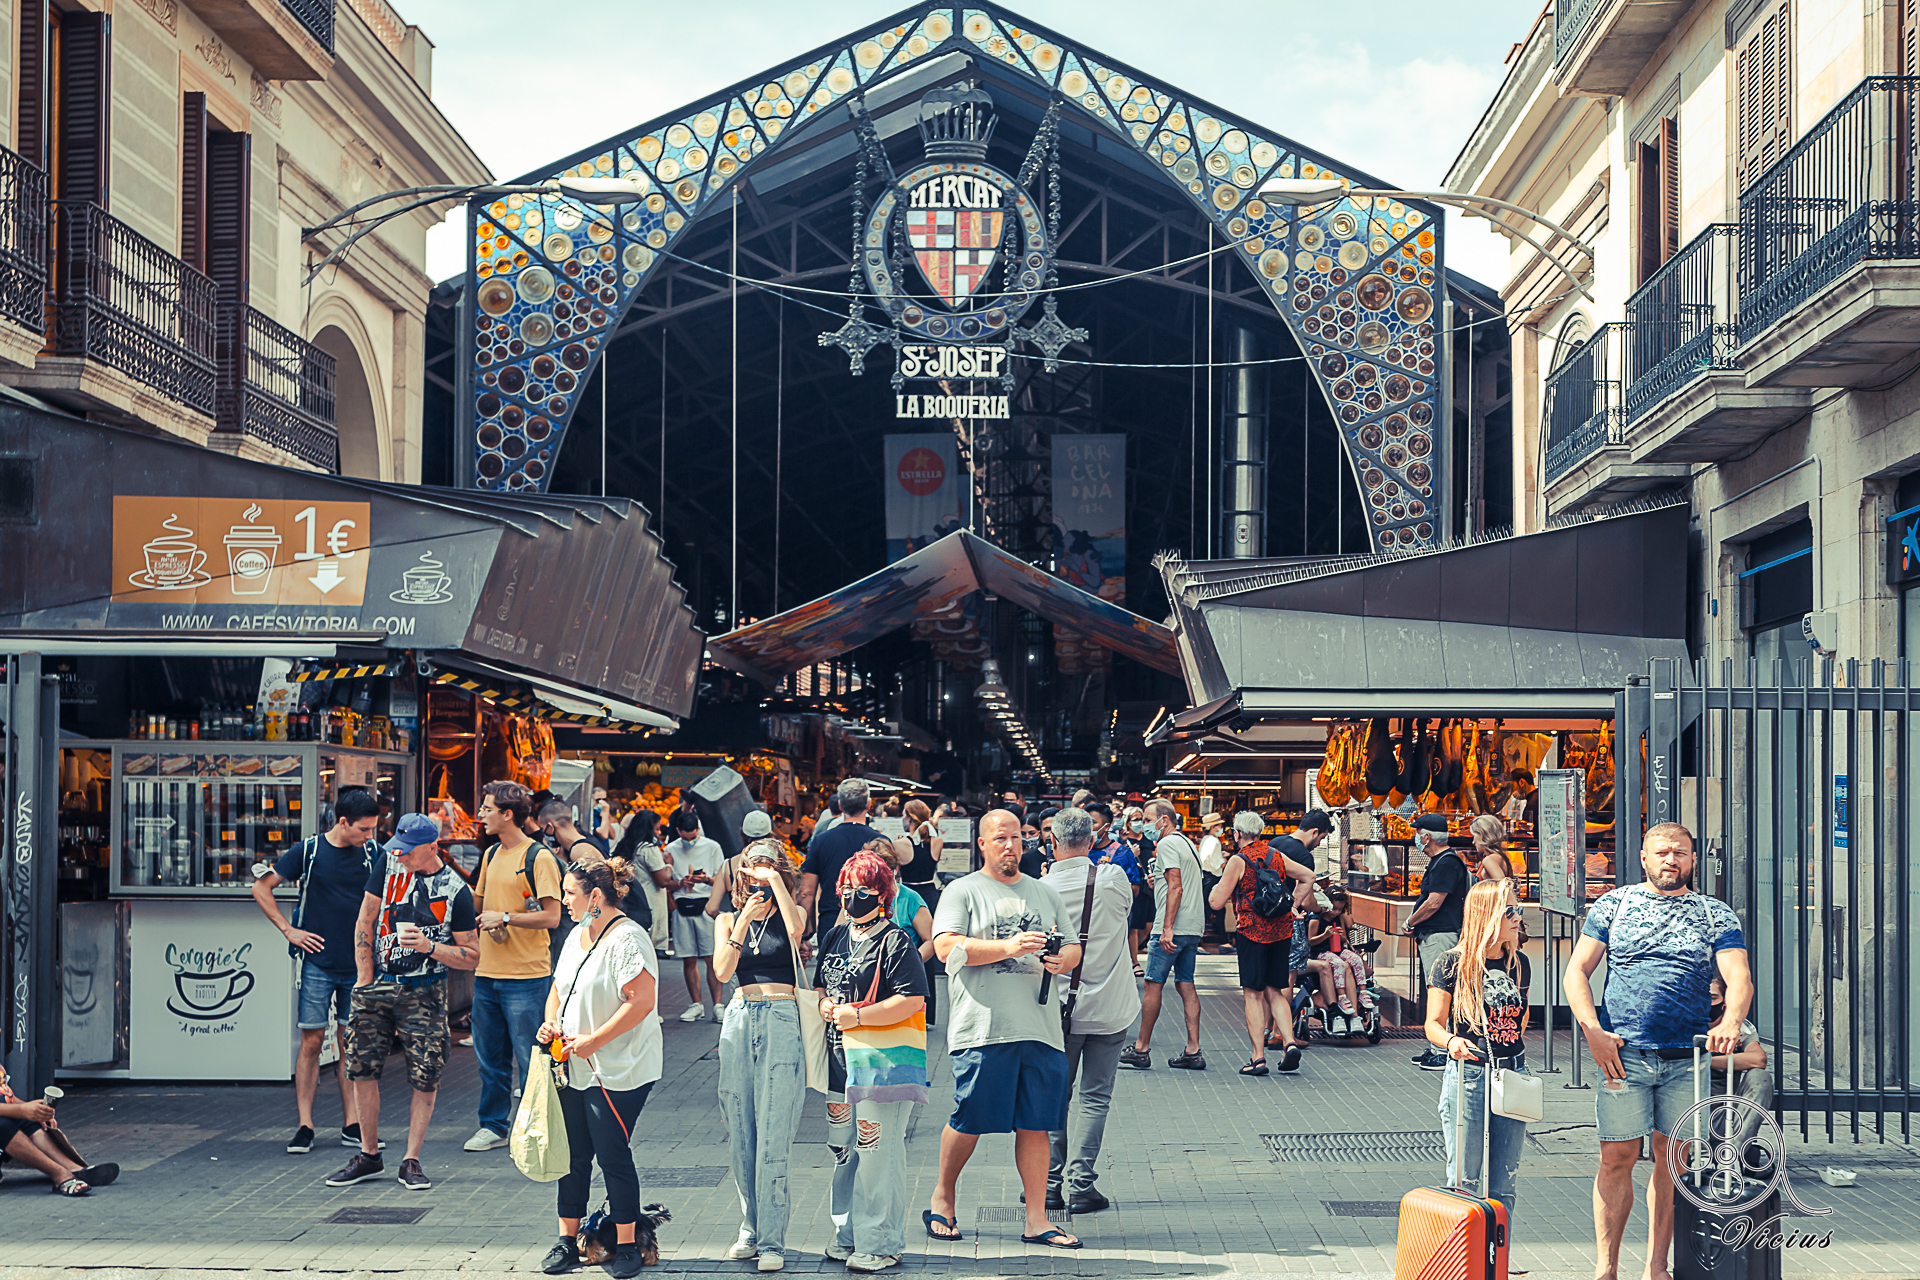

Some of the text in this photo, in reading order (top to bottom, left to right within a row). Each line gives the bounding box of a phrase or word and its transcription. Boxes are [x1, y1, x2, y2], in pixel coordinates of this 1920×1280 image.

[910, 174, 1002, 208] MERCAT
[924, 345, 1007, 377] JOSEP
[896, 394, 1010, 418] LA BOQUERIA
[901, 470, 942, 479] ESTRELLA
[239, 560, 264, 569] Coffee
[189, 1023, 210, 1037] great
